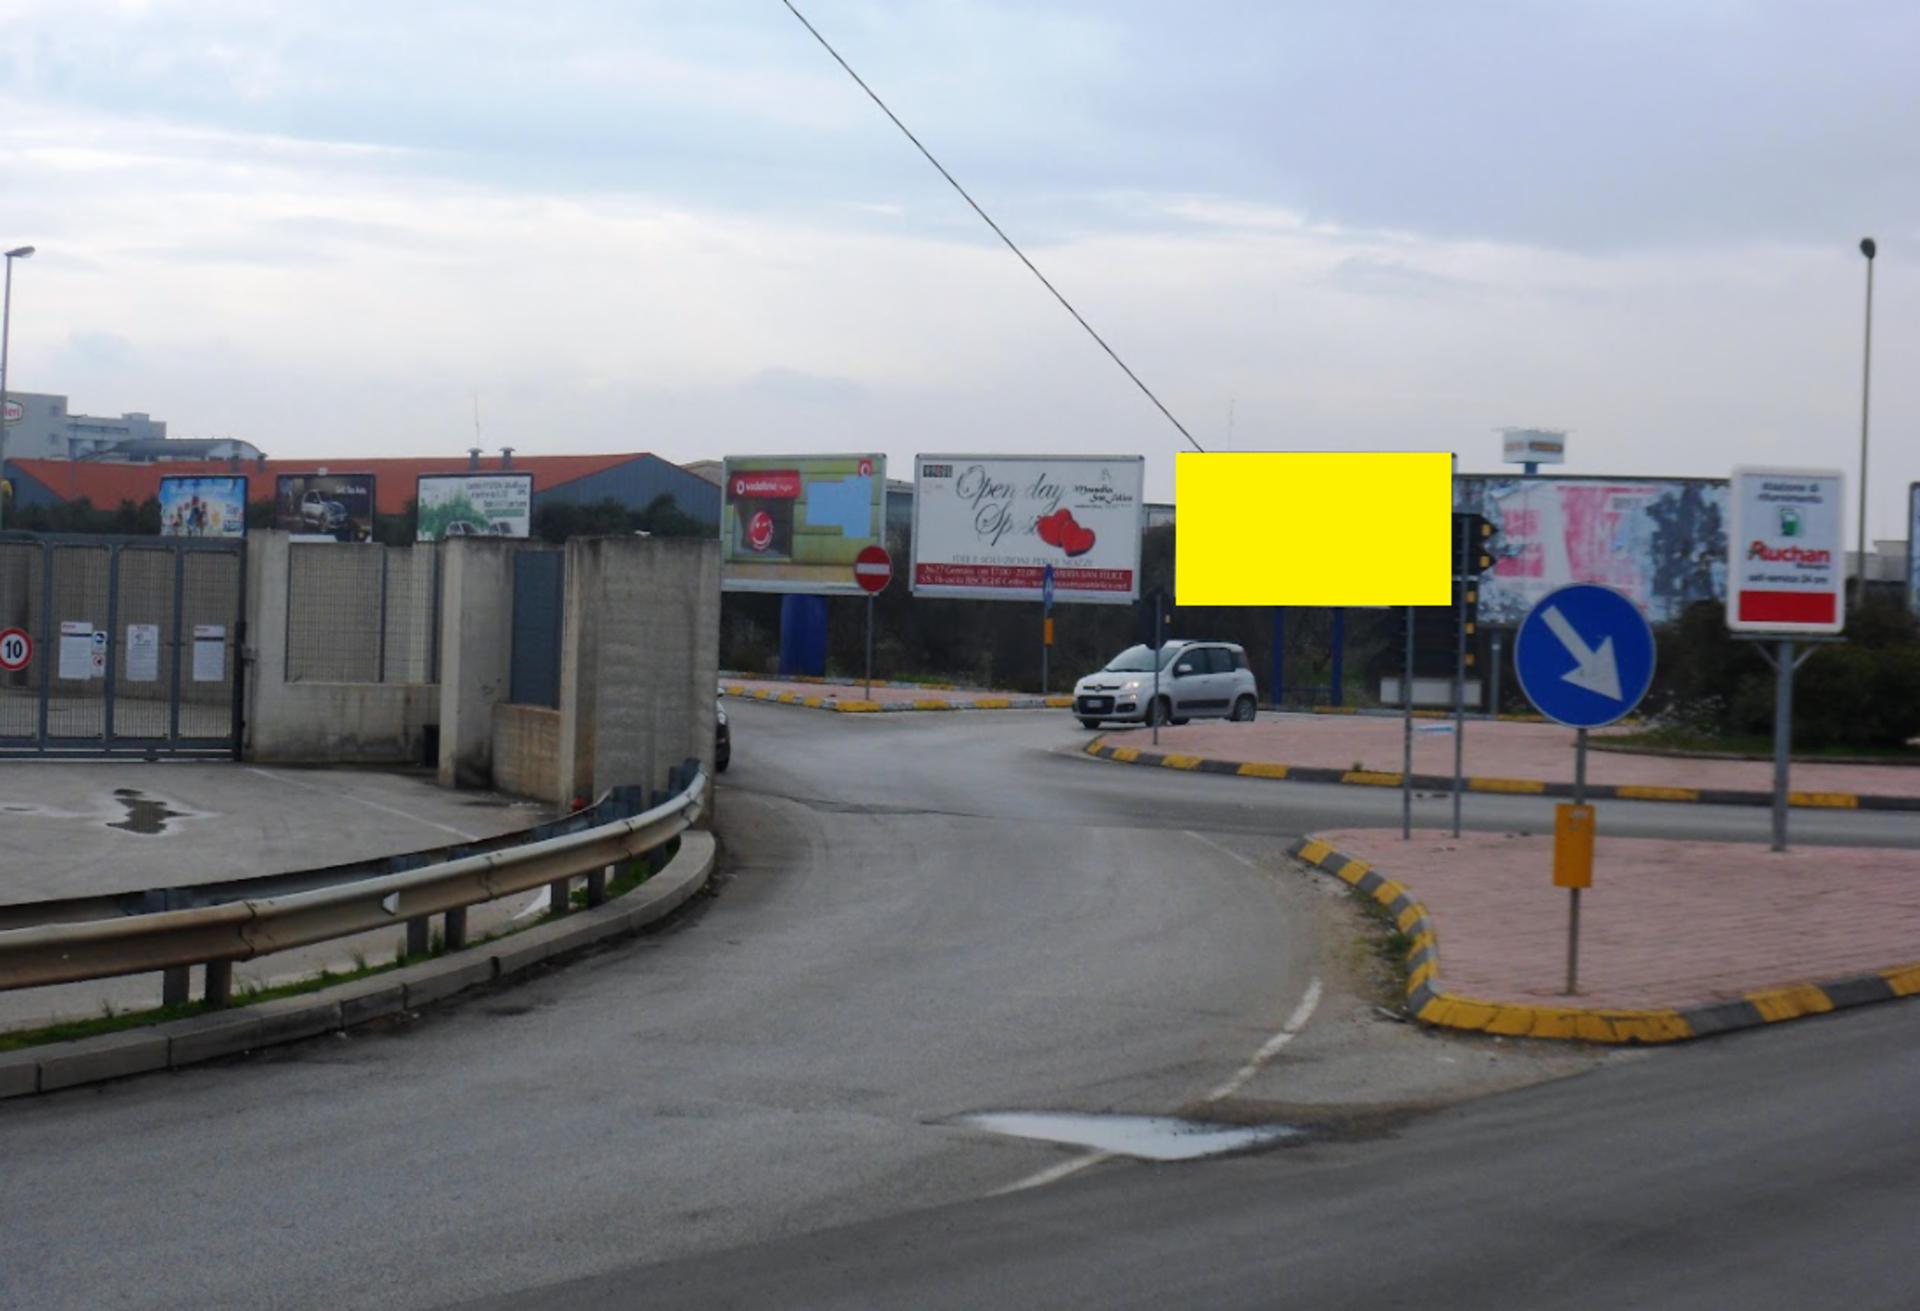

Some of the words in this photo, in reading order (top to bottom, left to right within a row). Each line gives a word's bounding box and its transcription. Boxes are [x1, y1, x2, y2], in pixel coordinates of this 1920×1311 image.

[956, 464, 1016, 510] Open
[1025, 472, 1066, 513] day
[1746, 540, 1830, 562] Auchan
[5, 639, 23, 659] 10
